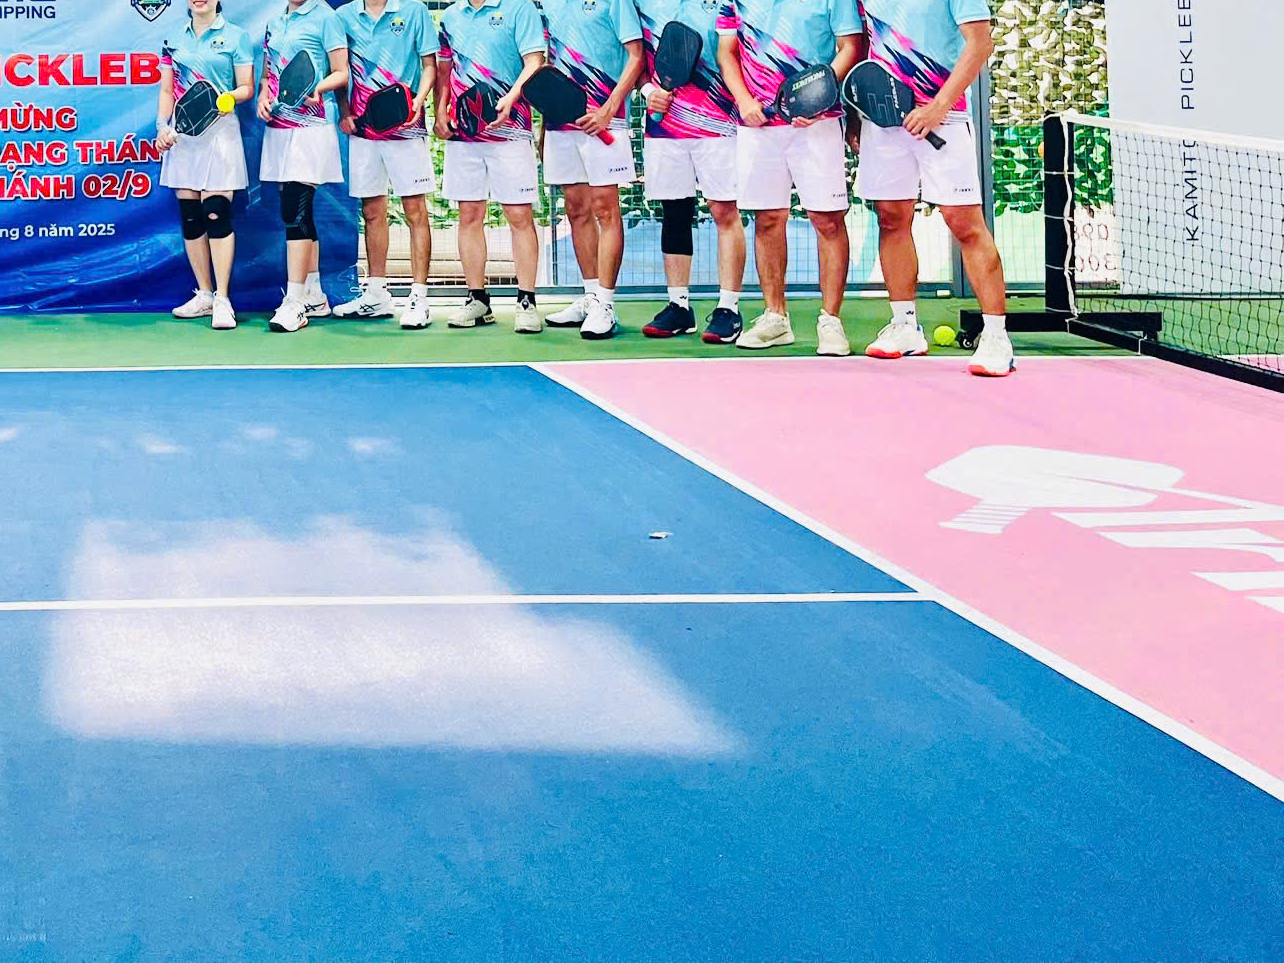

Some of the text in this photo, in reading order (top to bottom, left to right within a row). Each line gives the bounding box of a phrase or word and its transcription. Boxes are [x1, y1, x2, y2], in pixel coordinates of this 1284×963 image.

[83, 168, 151, 200] 02/9
[24, 224, 34, 237] 8
[38, 223, 74, 238] năm
[77, 223, 116, 237] 2025
